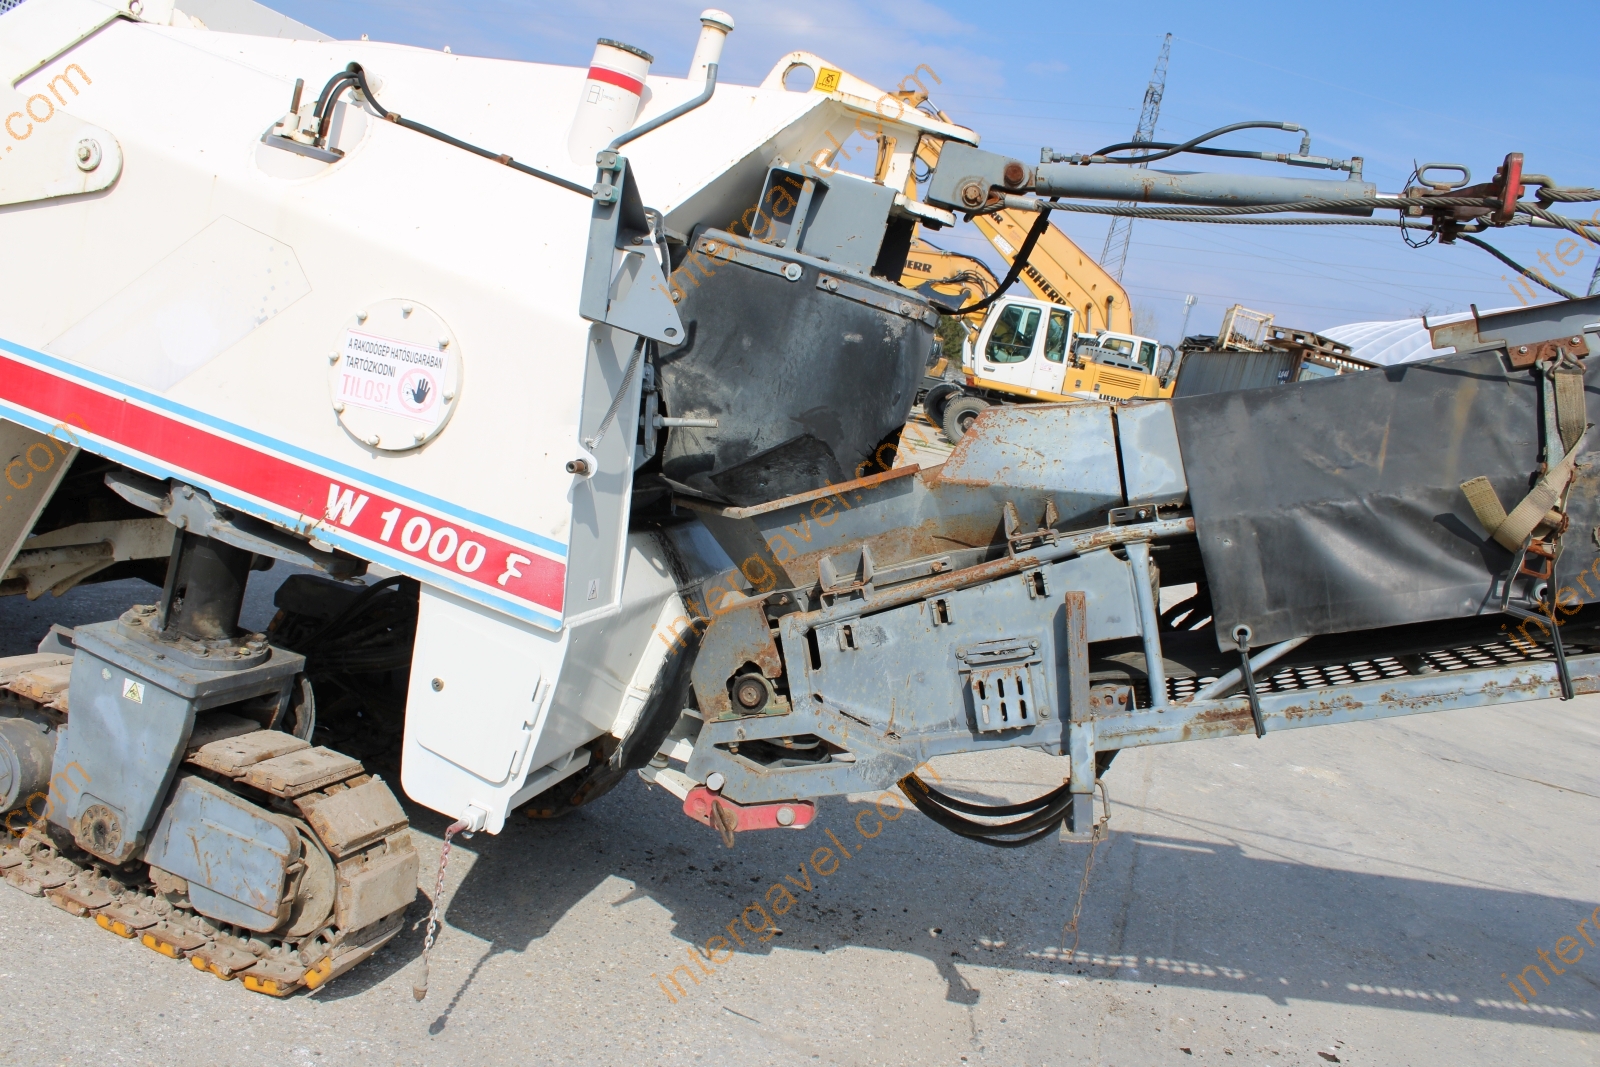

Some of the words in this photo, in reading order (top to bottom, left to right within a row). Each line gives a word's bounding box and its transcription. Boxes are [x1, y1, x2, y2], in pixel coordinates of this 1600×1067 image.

[346, 355, 396, 378] TARTÓZKODNI
[347, 338, 353, 349] A
[353, 339, 390, 357] RAKODÓGÉP
[390, 347, 444, 369] HATÓSUGARÁBAN
[342, 373, 392, 405] TILOS!
[325, 483, 370, 527] W
[380, 507, 487, 573] 1000
[497, 552, 532, 586] F
